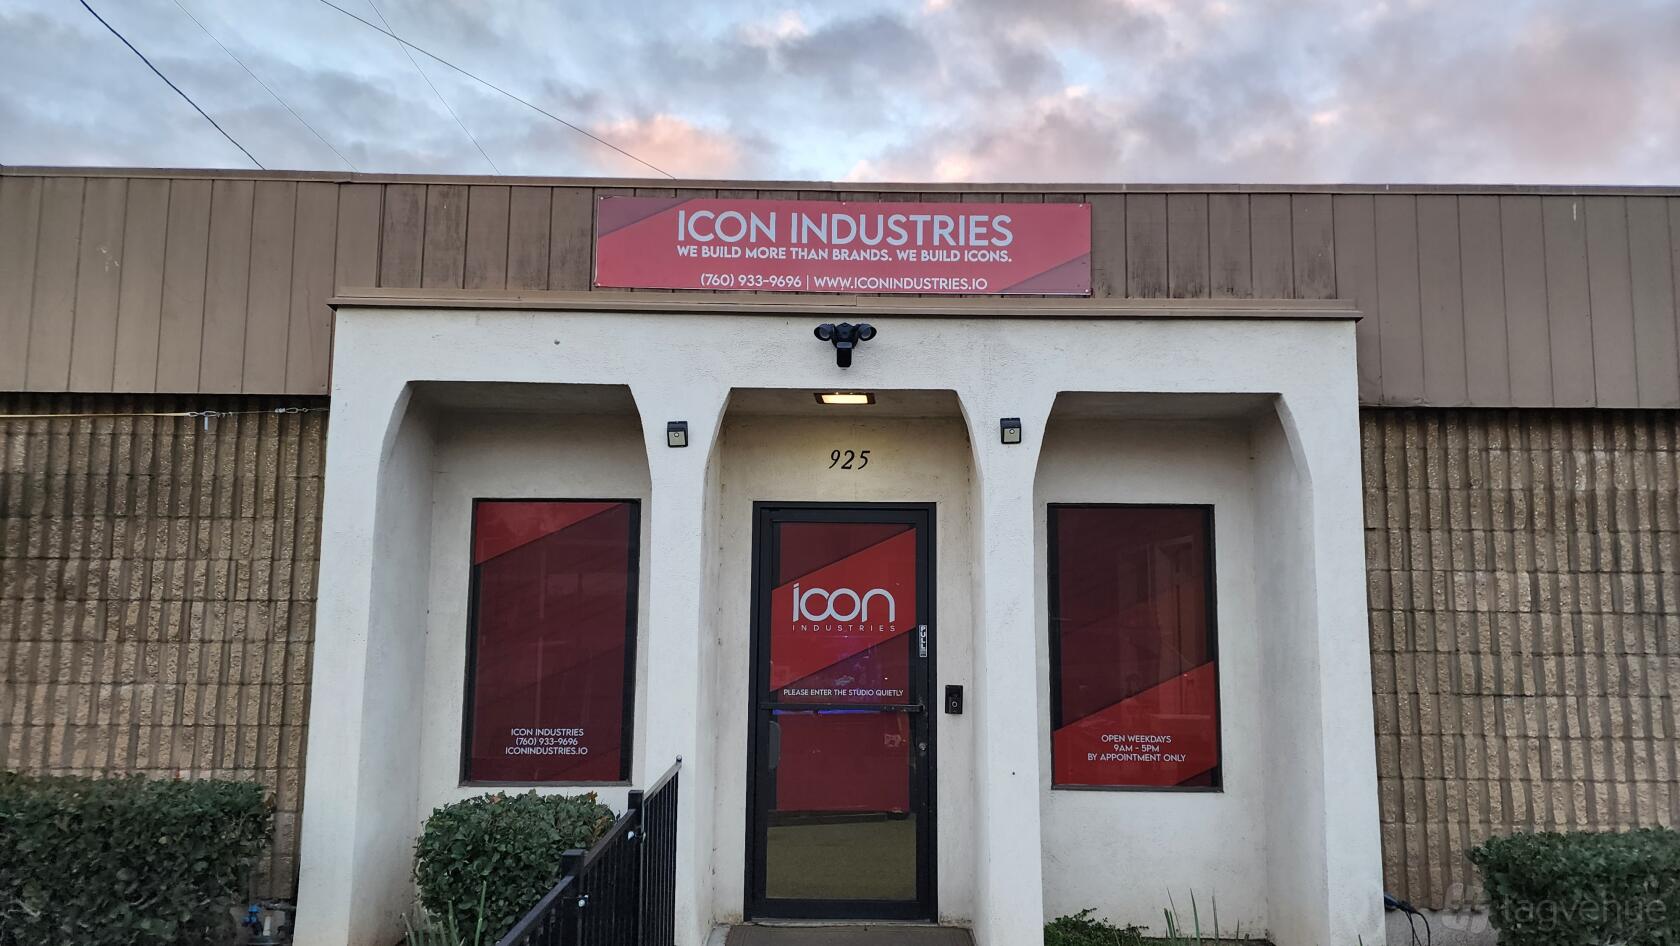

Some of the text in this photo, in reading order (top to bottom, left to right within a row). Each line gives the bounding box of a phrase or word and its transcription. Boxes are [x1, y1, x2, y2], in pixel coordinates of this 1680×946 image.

[677, 210, 1013, 246] ICON INDUSTRIES
[677, 245, 1012, 262] WE BUILD MORE THAN BRANDS. WE BUILD ICONS.
[700, 273, 735, 287] (760)
[738, 274, 801, 287] 933-9696
[814, 276, 988, 290] WWW.ICONINDUSTRIES.IO
[829, 449, 871, 470] 925
[875, 689, 904, 697] QUIETLY
[511, 728, 584, 736] ICON INDUSTRIES
[515, 737, 578, 746] (760) 933-9696
[1101, 735, 1171, 743] OPEN WEEKDAYS
[505, 746, 588, 755] ICONINDUSTRIES.IO
[1113, 744, 1133, 752] 9AM
[1087, 753, 1186, 762] BY APPOINTMENT ONLY
